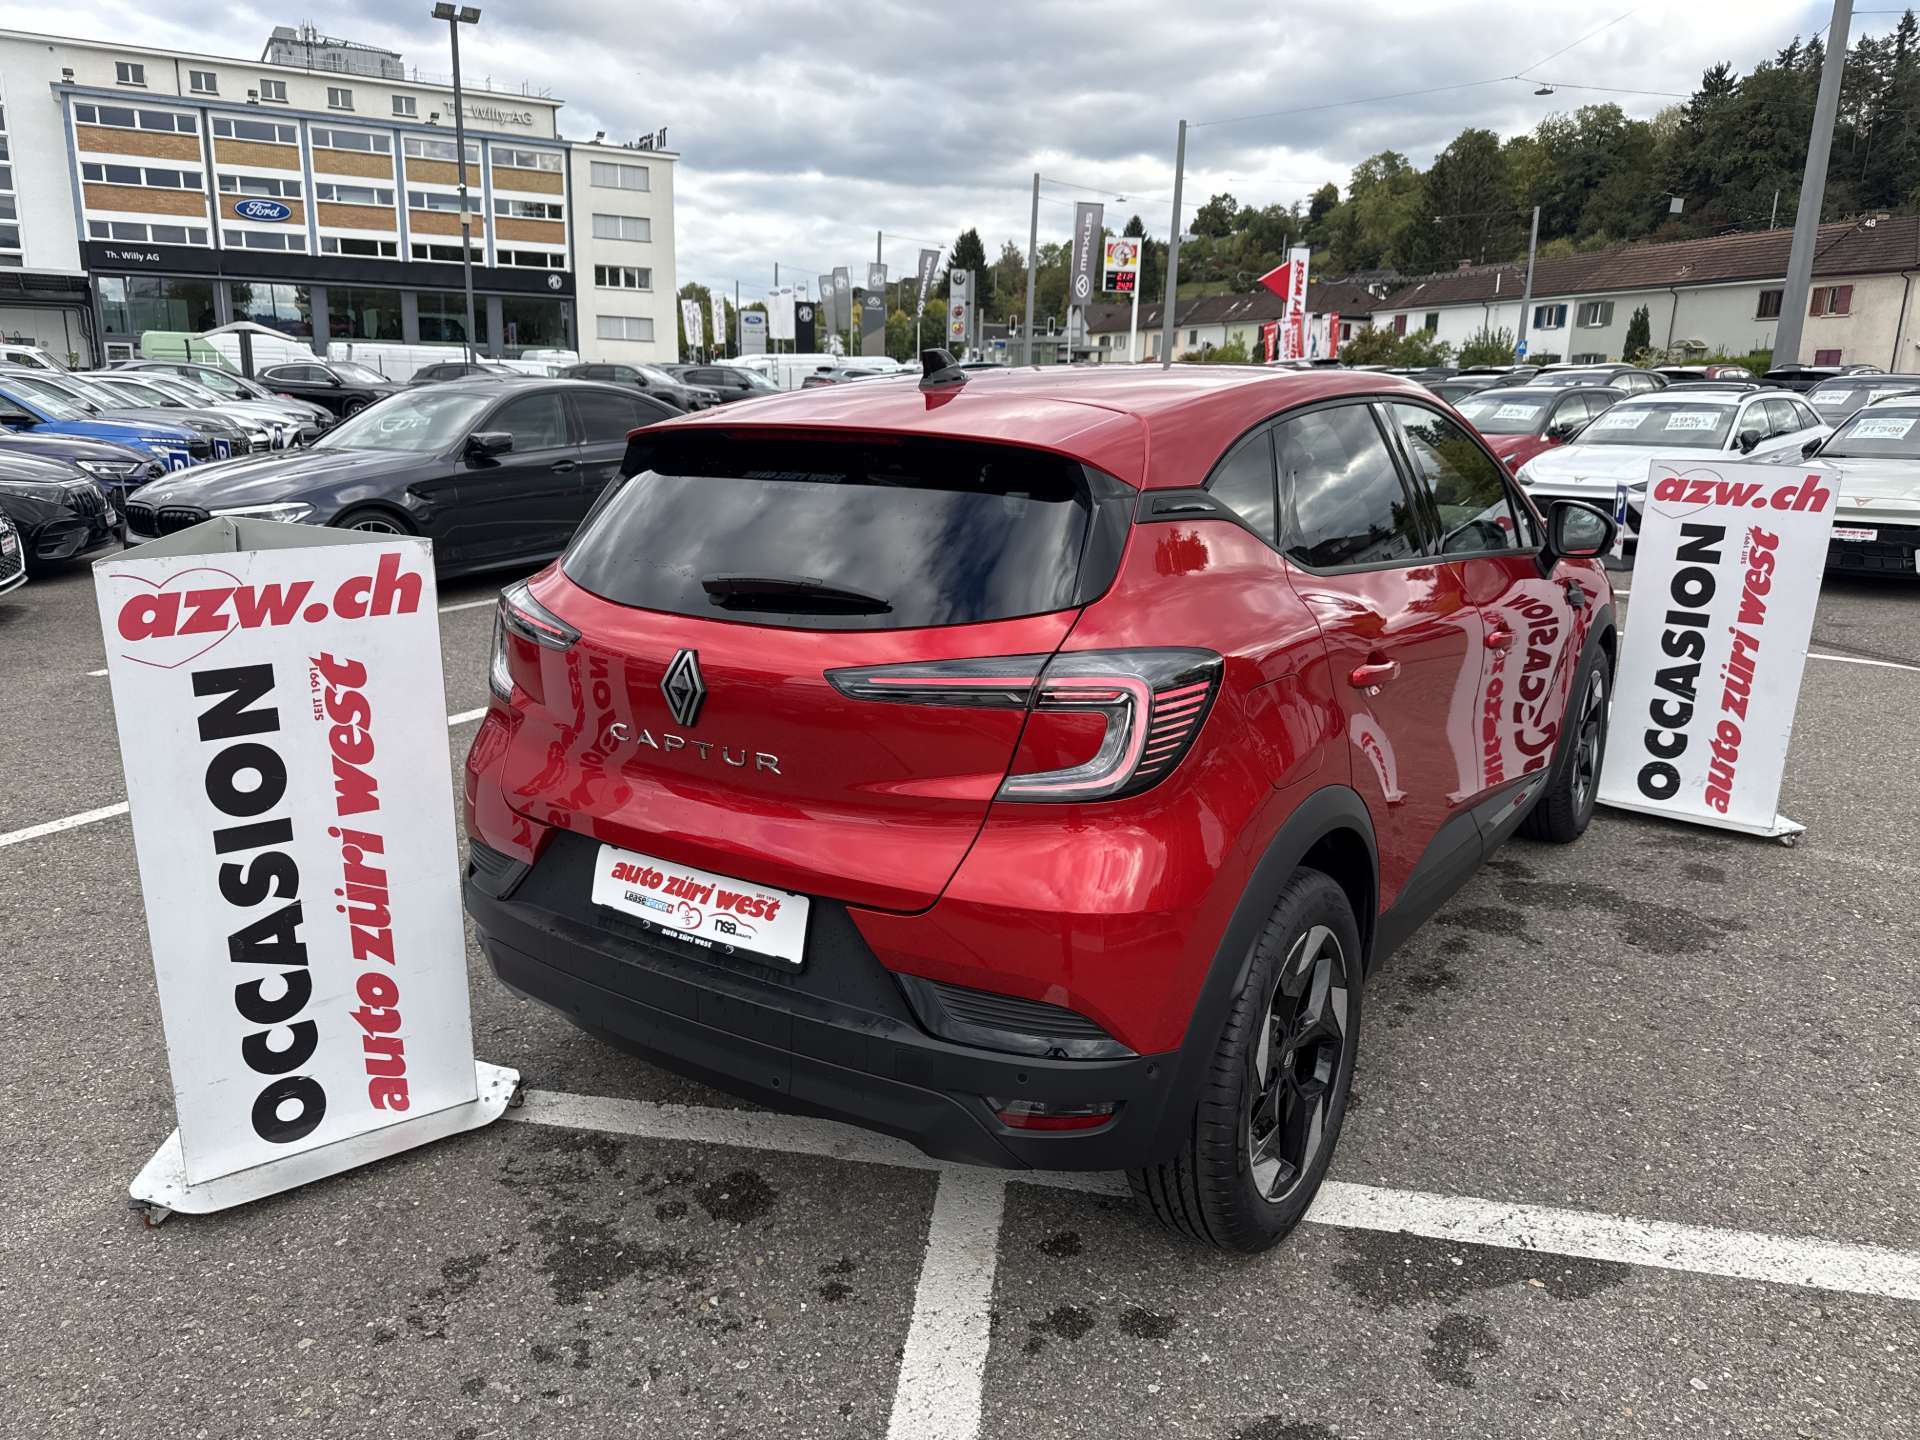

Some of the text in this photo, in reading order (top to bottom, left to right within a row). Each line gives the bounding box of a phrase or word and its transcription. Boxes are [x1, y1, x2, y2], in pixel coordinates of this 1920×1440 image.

[472, 104, 508, 126] Willy
[511, 113, 533, 126] AG
[246, 200, 281, 218] Ford
[105, 250, 160, 263] Th. Willy AG
[1616, 491, 1624, 518] P
[1653, 474, 1831, 513] azw.ch
[1740, 551, 1748, 565] SEIT
[117, 553, 423, 641] azw.ch
[1637, 523, 1726, 801] OCCASION
[1705, 525, 1779, 814] auto züri west
[309, 667, 325, 720] SEIT 1991
[609, 722, 782, 775] CAPTUR
[191, 663, 327, 1144] OCCASION
[308, 651, 412, 1112] auto züri west
[611, 861, 782, 922] auto züri west
[661, 927, 713, 949] auto züri west
[715, 918, 737, 935] nsa
